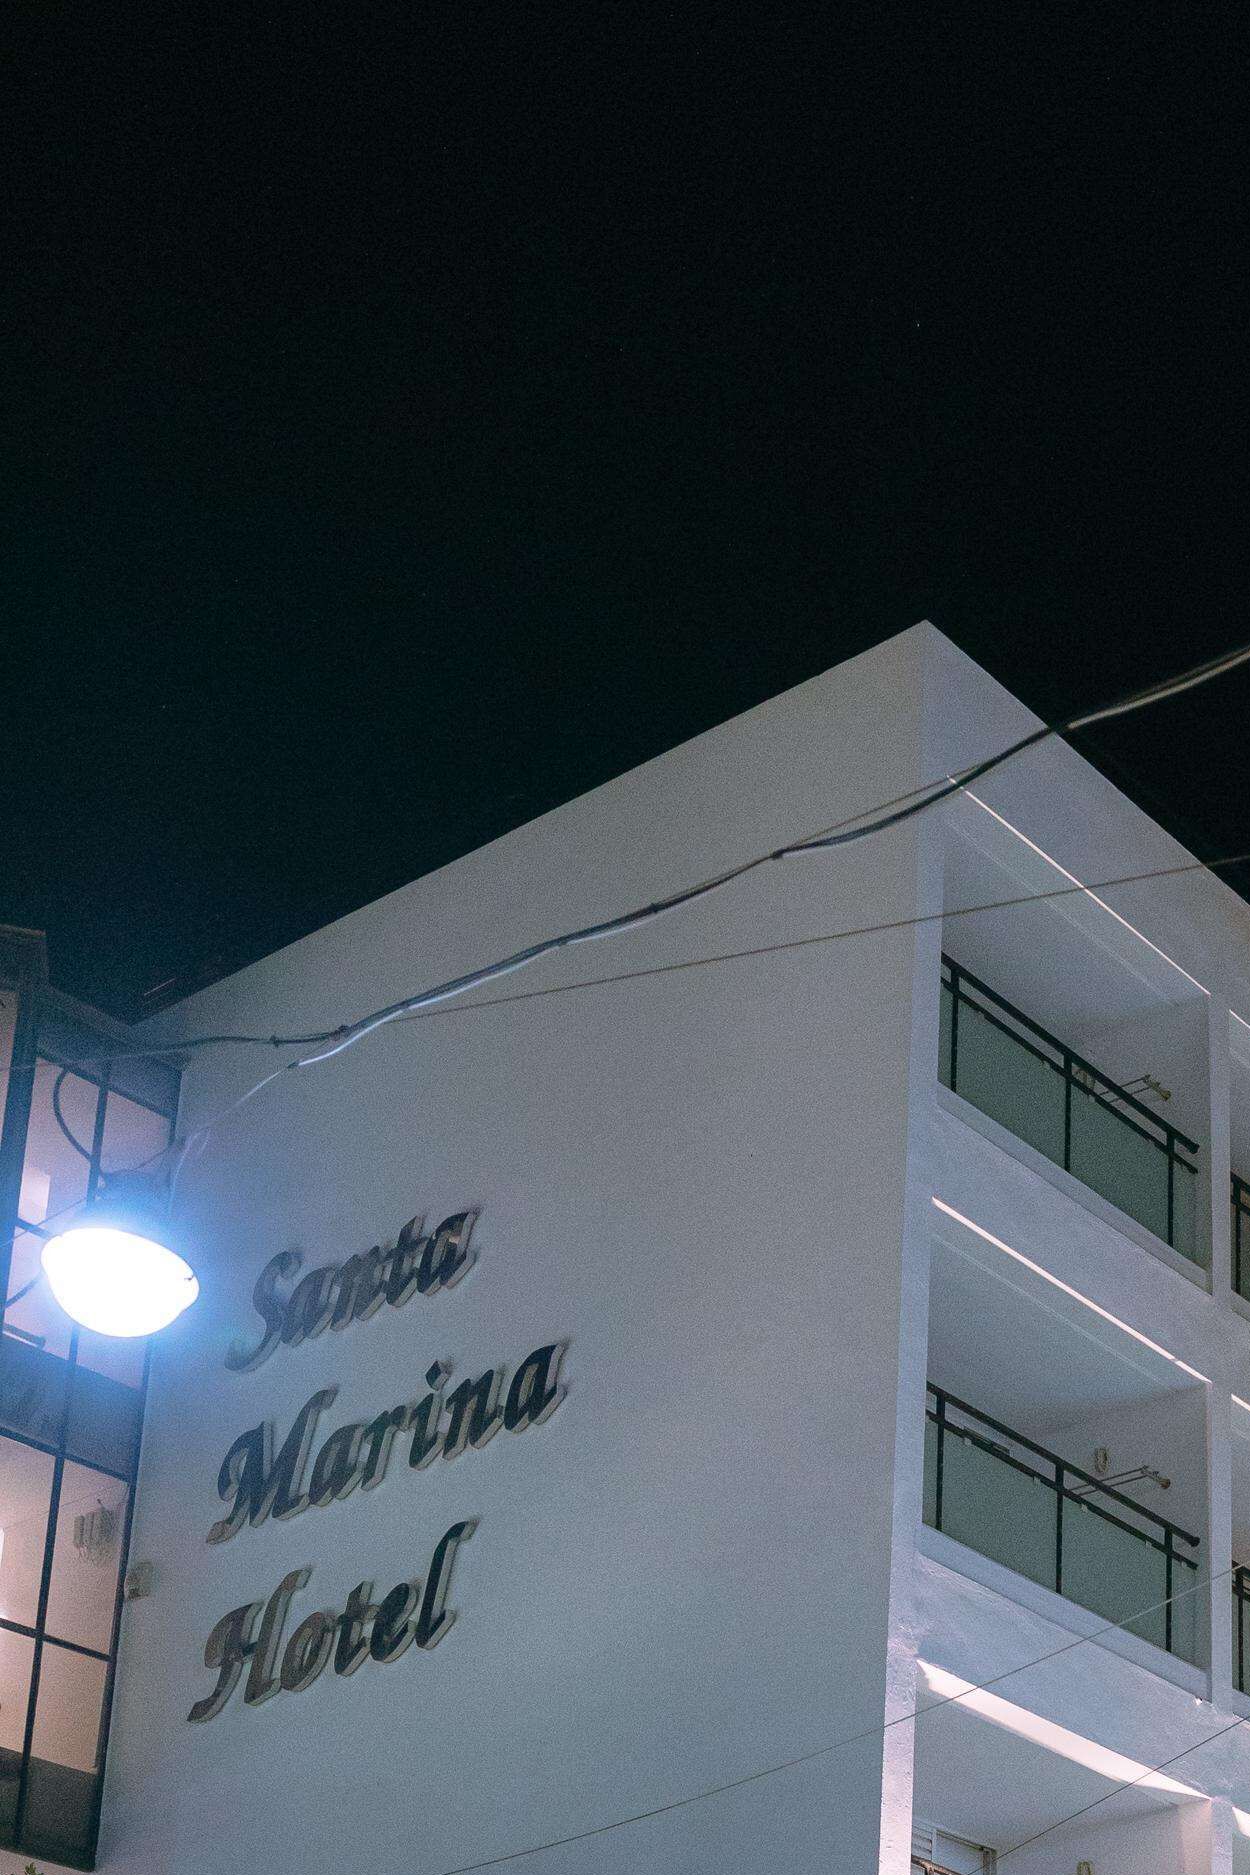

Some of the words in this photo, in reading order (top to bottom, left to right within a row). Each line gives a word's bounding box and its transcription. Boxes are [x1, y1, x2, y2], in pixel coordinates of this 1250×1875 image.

[225, 1208, 481, 1372] Santa
[206, 1341, 570, 1545] Marina
[187, 1518, 480, 1723] Hotel
